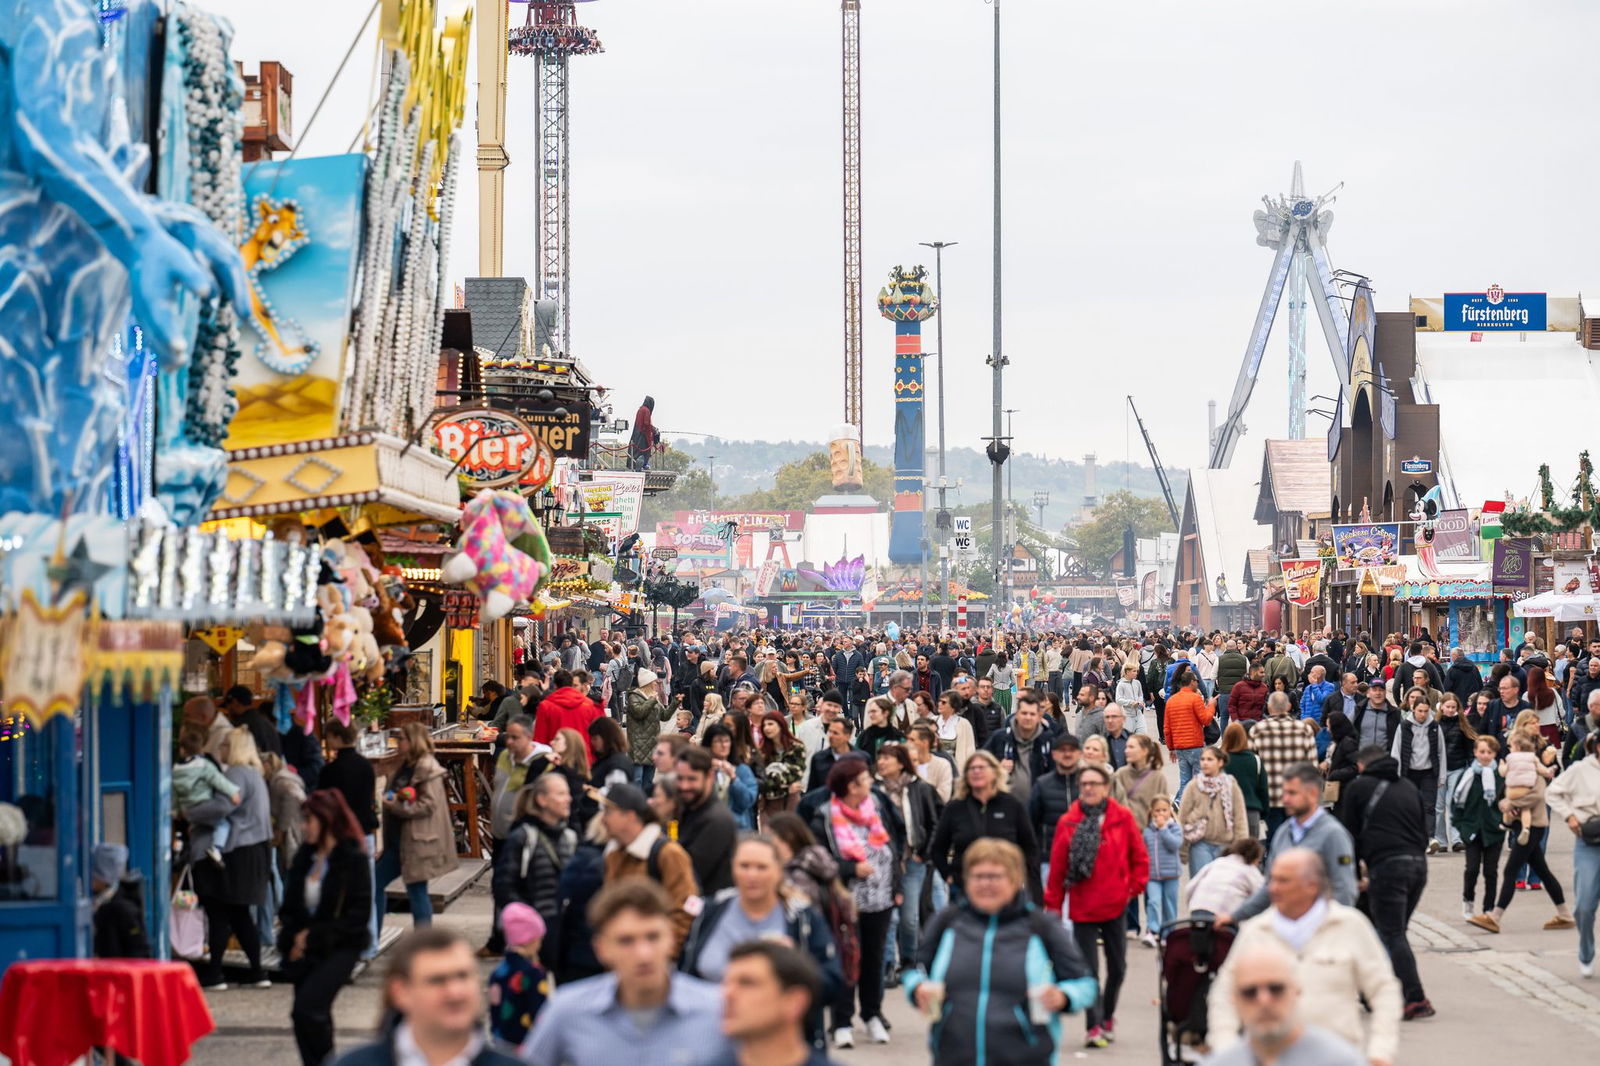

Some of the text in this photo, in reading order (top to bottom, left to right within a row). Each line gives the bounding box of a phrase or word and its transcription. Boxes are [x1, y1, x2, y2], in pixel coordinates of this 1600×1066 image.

[439, 422, 527, 466] Bier
[615, 497, 635, 505] ghetti
[956, 519, 970, 530] WC
[1437, 520, 1464, 531] OOD
[955, 537, 970, 547] WC
[1437, 541, 1470, 557] angos
[1286, 565, 1318, 580] Churros
